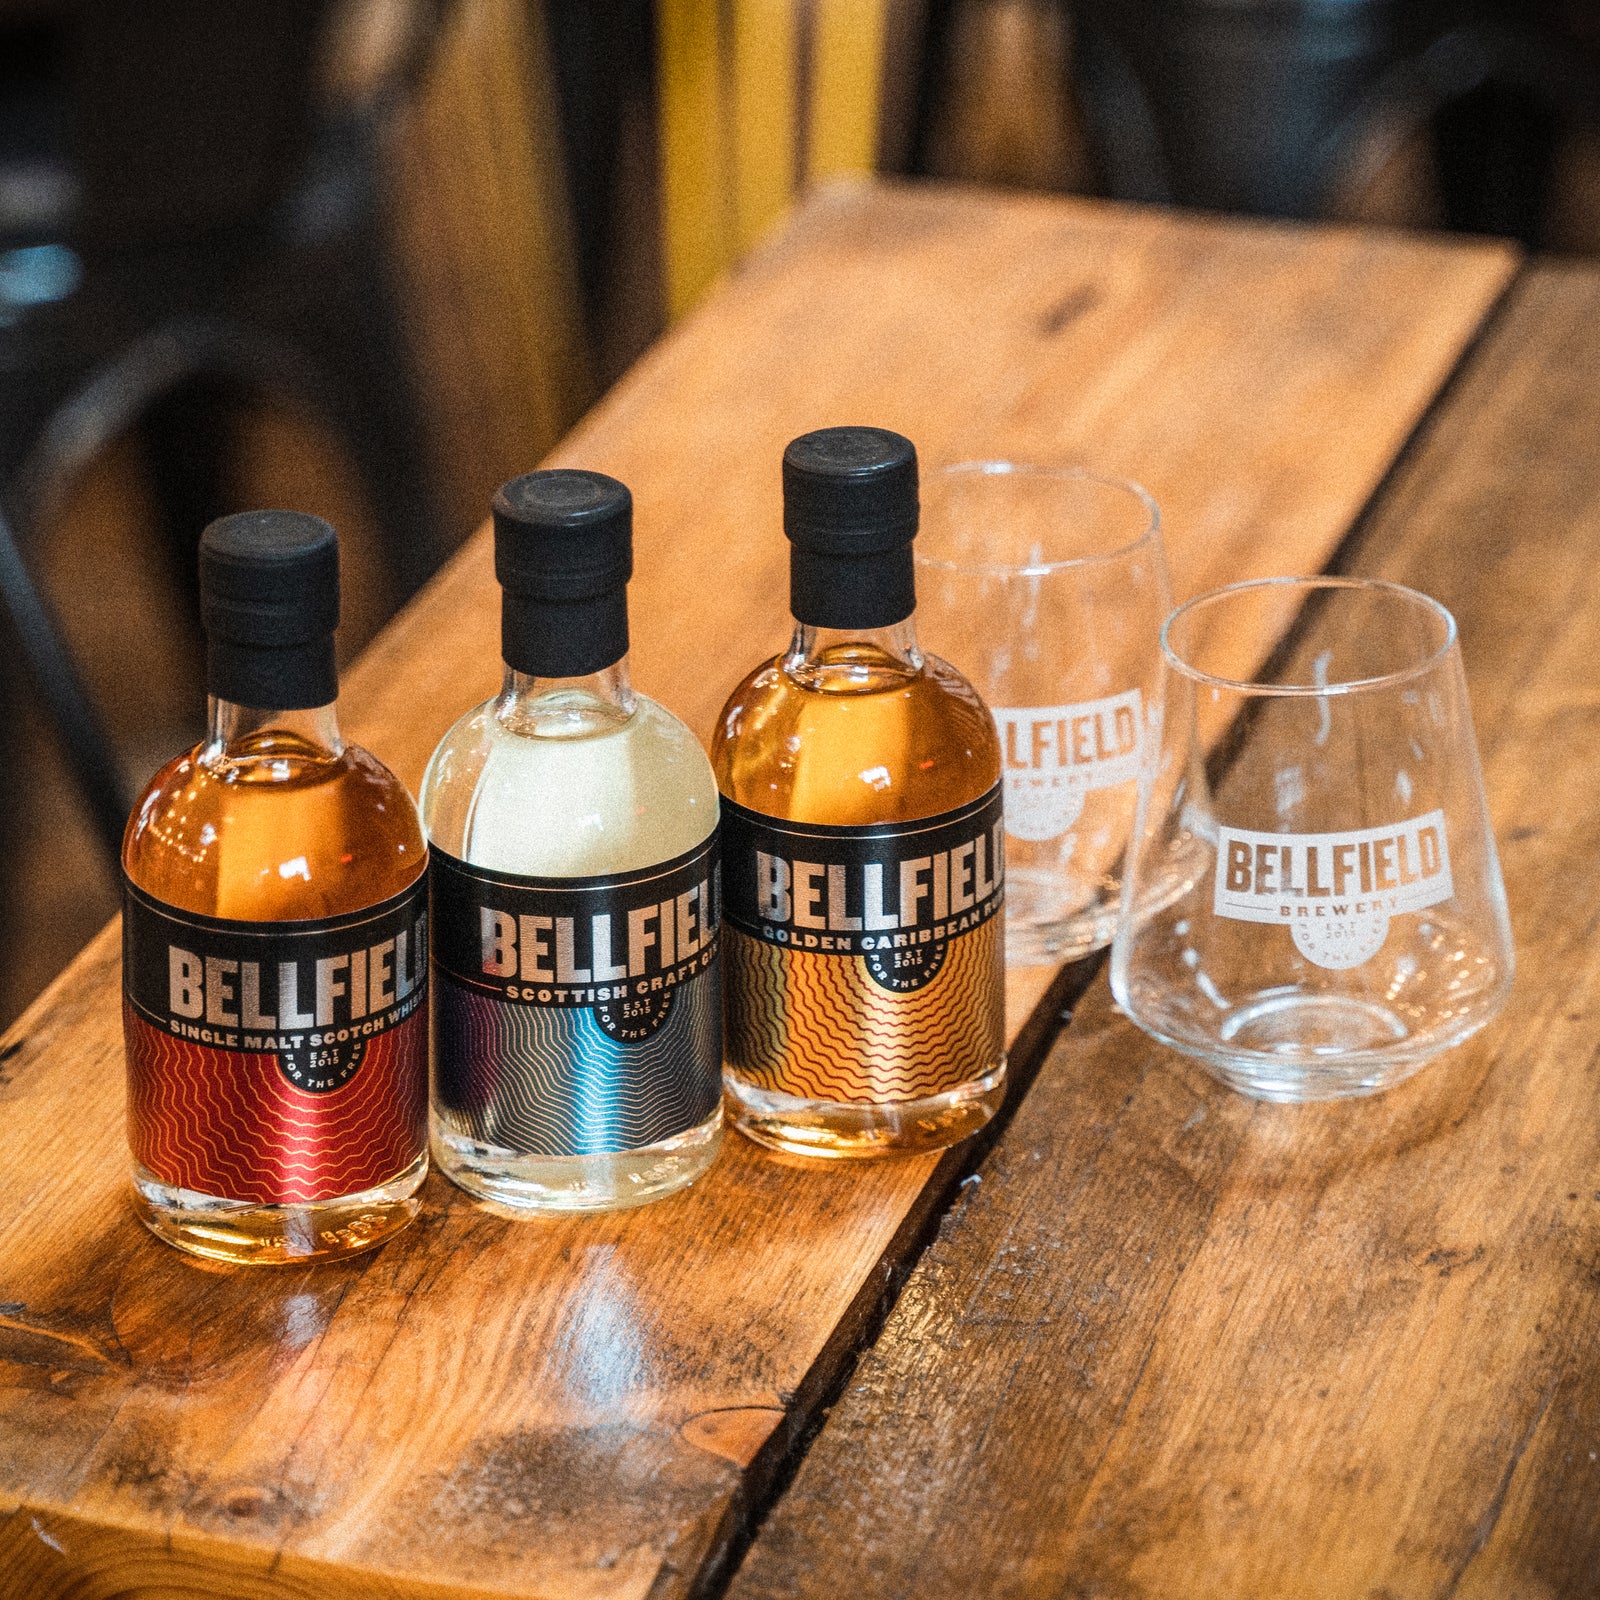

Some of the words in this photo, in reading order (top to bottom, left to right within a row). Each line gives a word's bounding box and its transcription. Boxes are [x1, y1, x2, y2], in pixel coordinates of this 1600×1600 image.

[1006, 705, 1136, 769] LFIELD
[757, 816, 1004, 931] BELLFIELD
[1226, 826, 1442, 897] BELLFIELD
[1280, 896, 1399, 917] BREWERY
[763, 925, 851, 951] GOLDEN
[861, 908, 981, 951] CARIBBEAN
[169, 910, 428, 1030] BELLFIELD
[894, 949, 923, 960] EST
[894, 957, 923, 968] 2015
[506, 984, 628, 1003] SCOTTISH
[636, 962, 698, 995] CRAFT
[870, 954, 888, 980] FOR
[892, 978, 919, 988] THE
[623, 998, 651, 1011] EST
[623, 1006, 651, 1018] 2015
[170, 1019, 239, 1048] SINGLE
[244, 1035, 304, 1049] MALT
[310, 1017, 385, 1047] SCOTCH
[600, 1006, 616, 1032] FOR
[621, 1027, 648, 1038] THE
[285, 1054, 302, 1080] FOR
[307, 1078, 334, 1089] THE
[340, 1042, 361, 1078] FREE
[310, 1048, 339, 1060] EST
[310, 1056, 339, 1068] 2015
